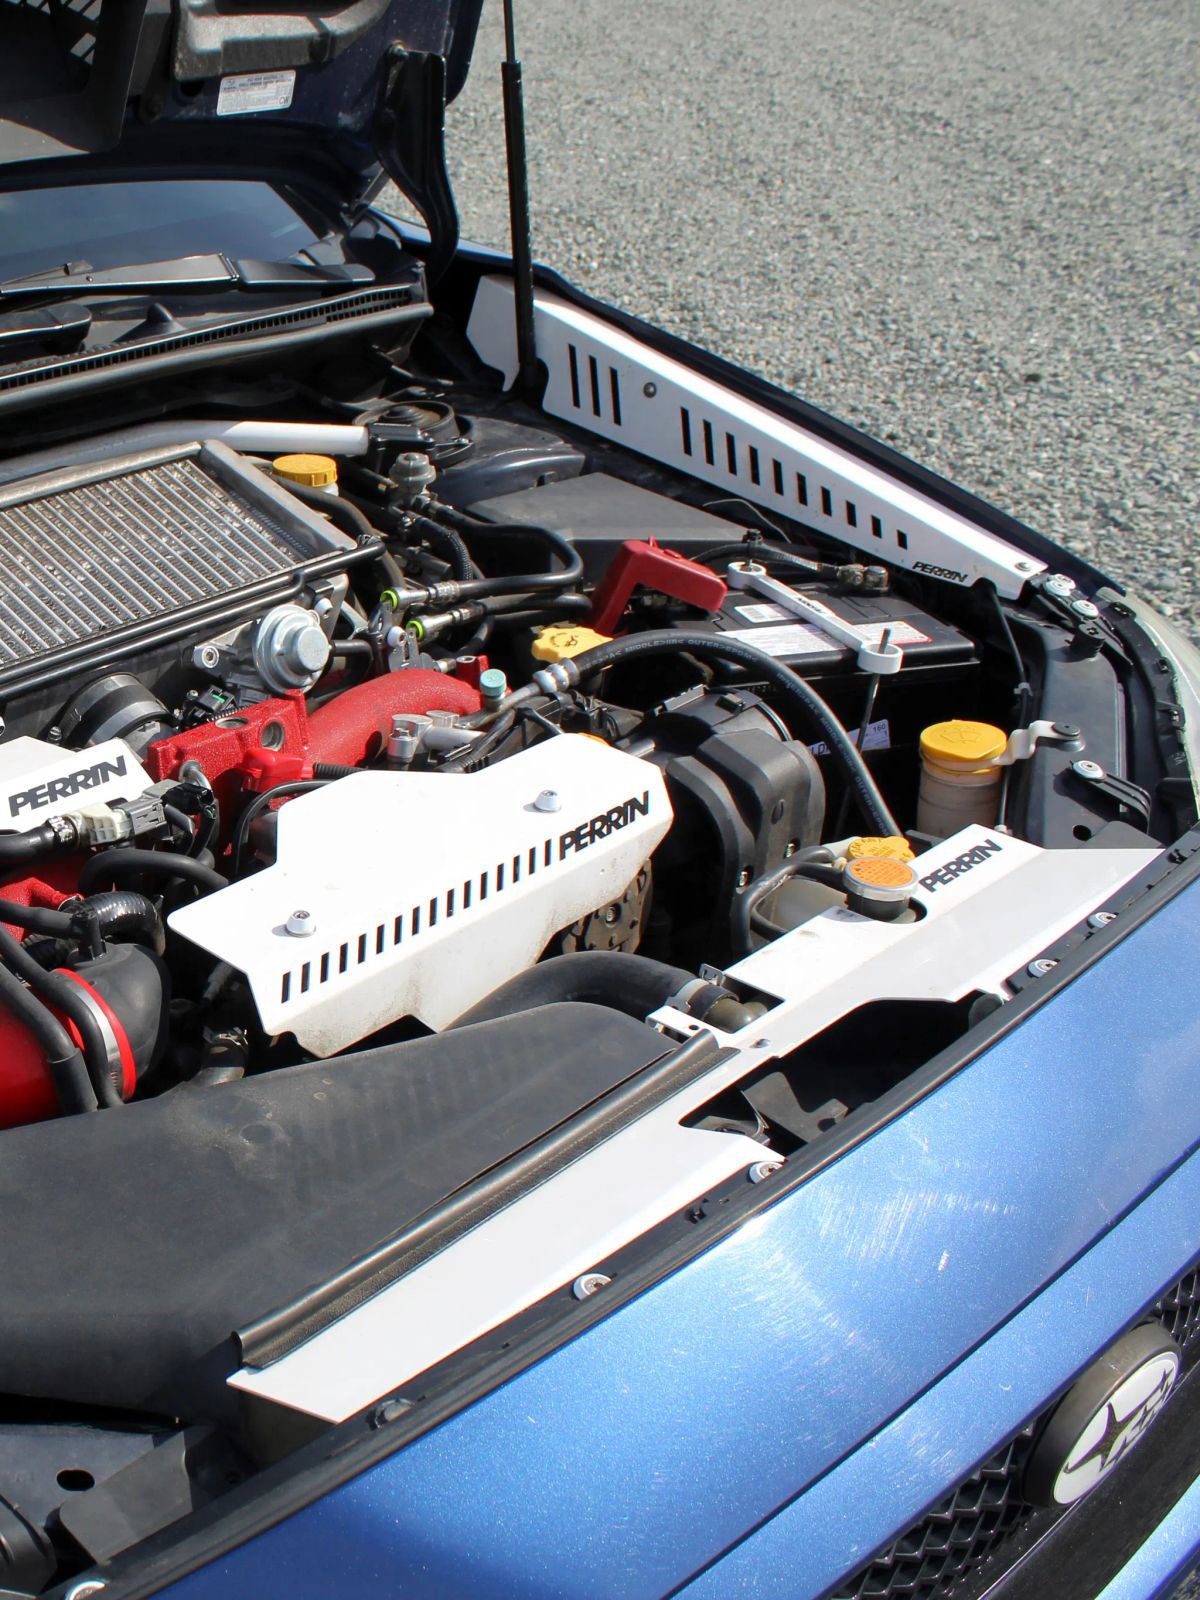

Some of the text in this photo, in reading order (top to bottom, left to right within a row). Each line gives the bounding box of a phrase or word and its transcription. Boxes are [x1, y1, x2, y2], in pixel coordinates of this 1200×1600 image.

[911, 560, 969, 583] PERRIN
[8, 754, 128, 818] PERRIN
[559, 790, 649, 861] PERRIN
[918, 838, 1003, 893] PERRIN
